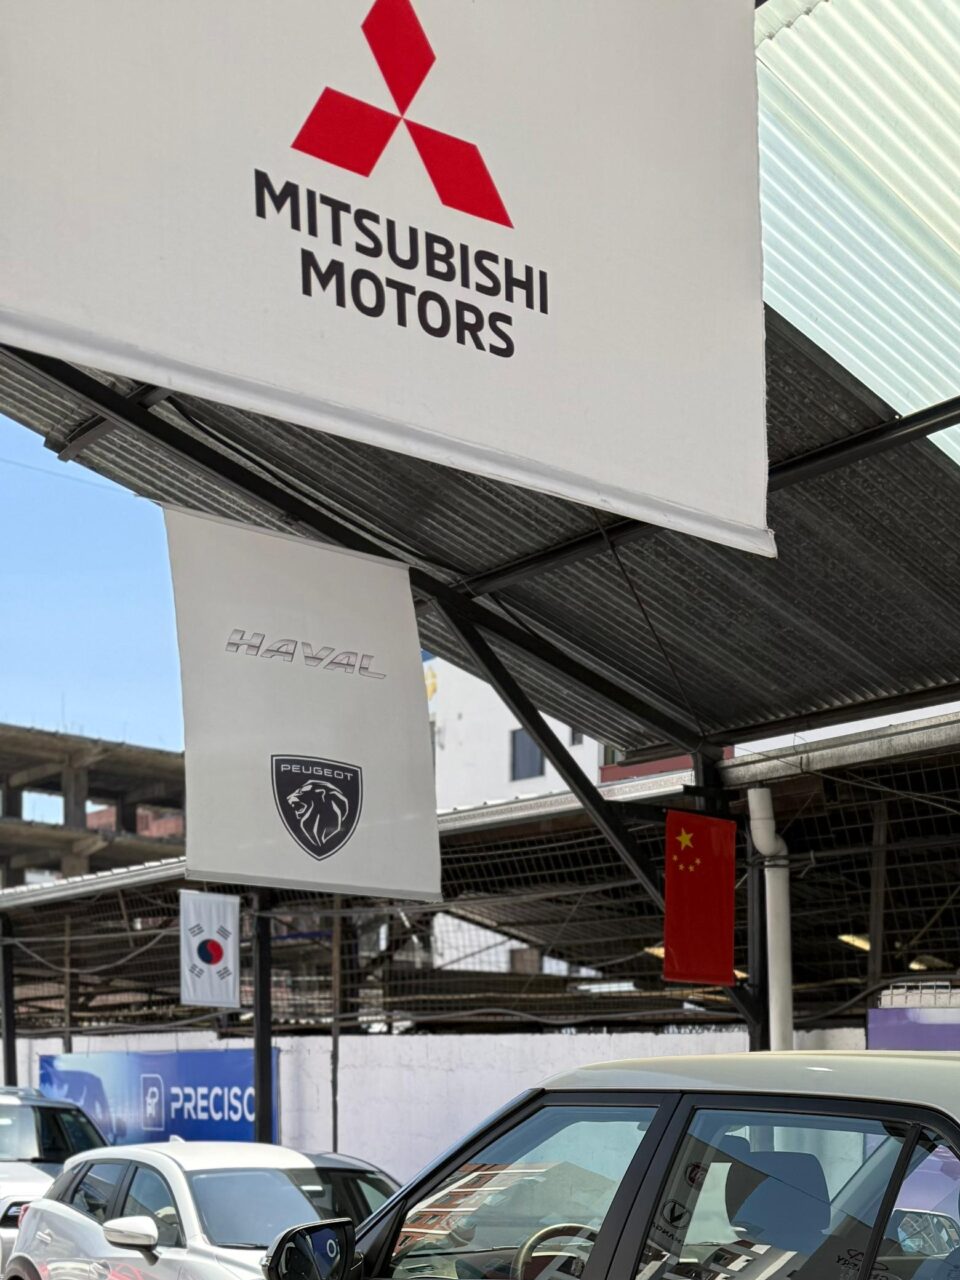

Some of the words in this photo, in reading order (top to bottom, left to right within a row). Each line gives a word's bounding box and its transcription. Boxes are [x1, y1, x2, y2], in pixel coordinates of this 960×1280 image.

[254, 168, 549, 315] MITSUBISHI
[300, 247, 515, 358] MOTORS
[225, 628, 387, 680] HAVAL
[280, 763, 353, 781] PEUGEOT
